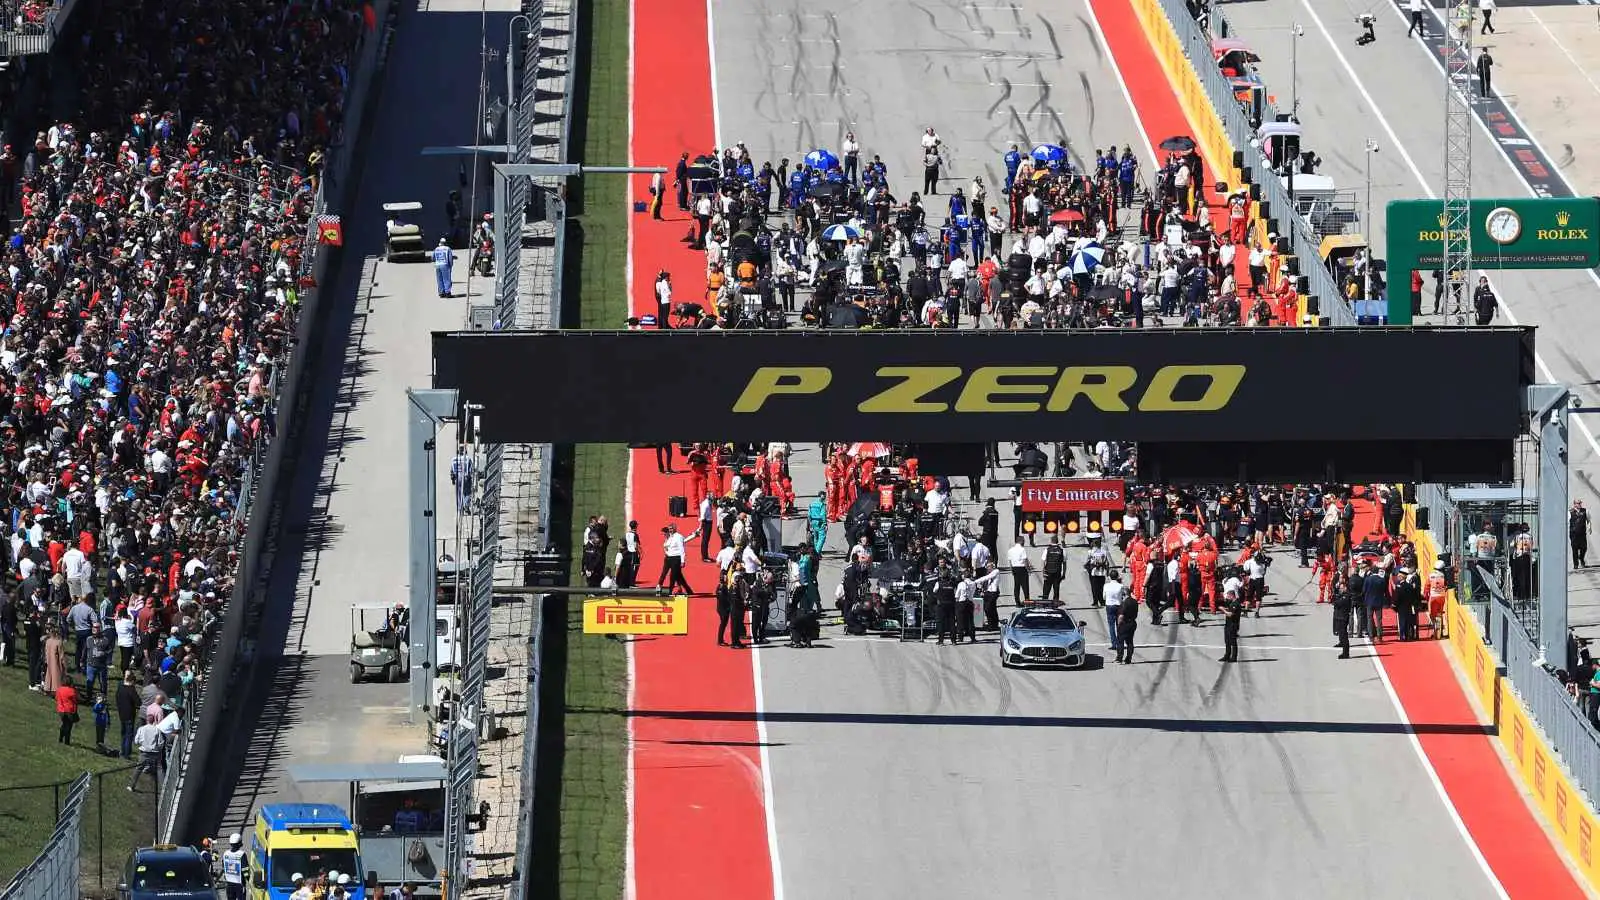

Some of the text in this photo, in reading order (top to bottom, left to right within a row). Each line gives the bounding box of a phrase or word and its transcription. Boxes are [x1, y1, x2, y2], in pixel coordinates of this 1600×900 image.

[1538, 229, 1588, 240] ROLEX
[732, 365, 1246, 413] P ZERO
[1027, 487, 1120, 502] Fly Emirates
[597, 606, 674, 624] PIRELLI
